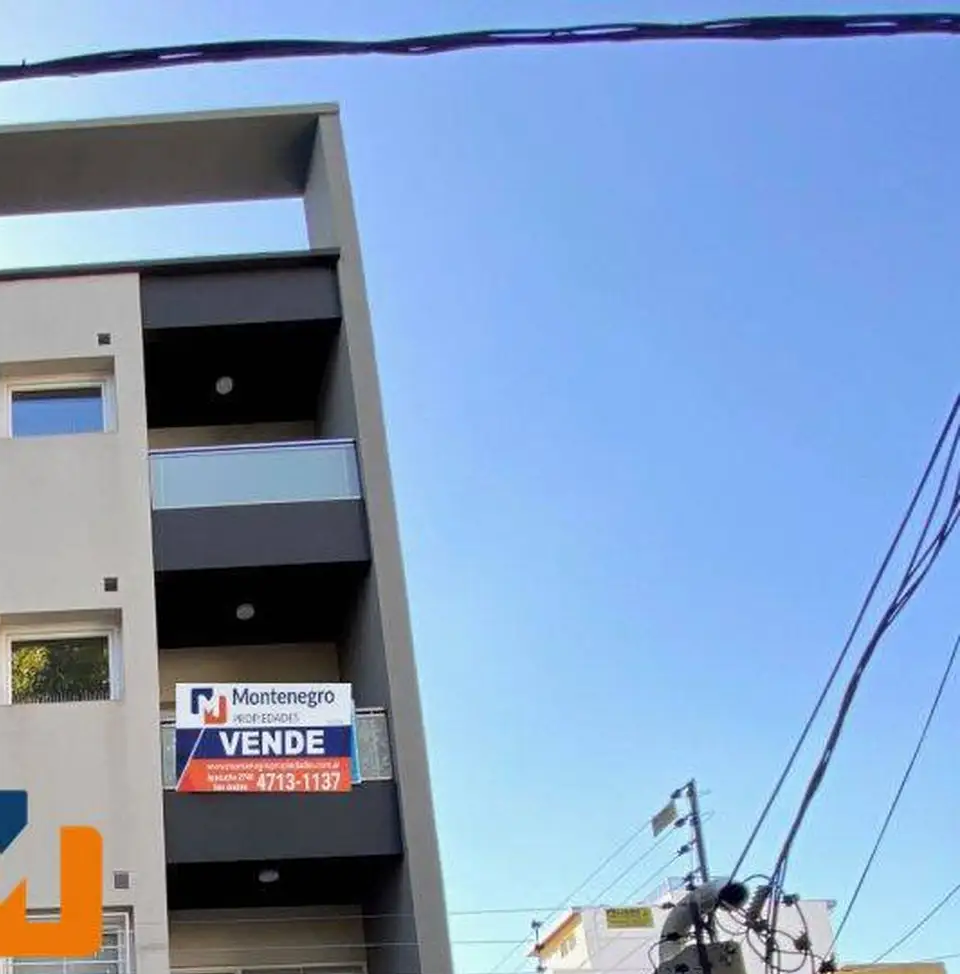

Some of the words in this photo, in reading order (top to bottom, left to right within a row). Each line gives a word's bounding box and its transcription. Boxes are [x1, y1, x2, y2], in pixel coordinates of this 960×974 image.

[232, 688, 335, 708] Montenegro
[218, 730, 325, 756] VENDE
[256, 772, 341, 791] 4713-1137
